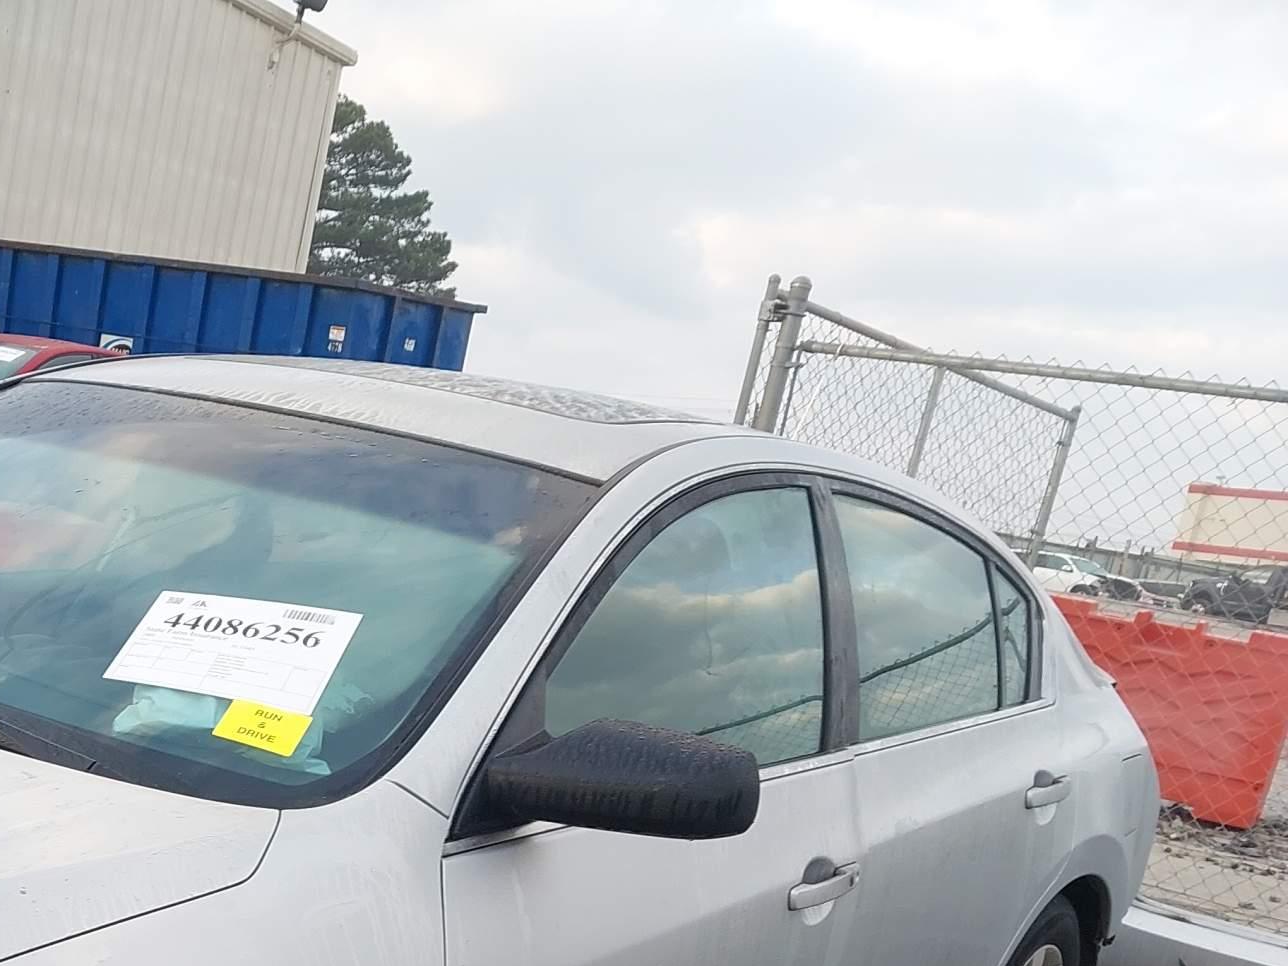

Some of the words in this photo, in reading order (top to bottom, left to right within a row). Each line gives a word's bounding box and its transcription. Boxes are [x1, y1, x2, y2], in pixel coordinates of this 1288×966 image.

[164, 612, 325, 648] 44086256
[254, 709, 283, 722] RUN
[257, 721, 266, 729] &
[237, 726, 276, 743] DRIVE
